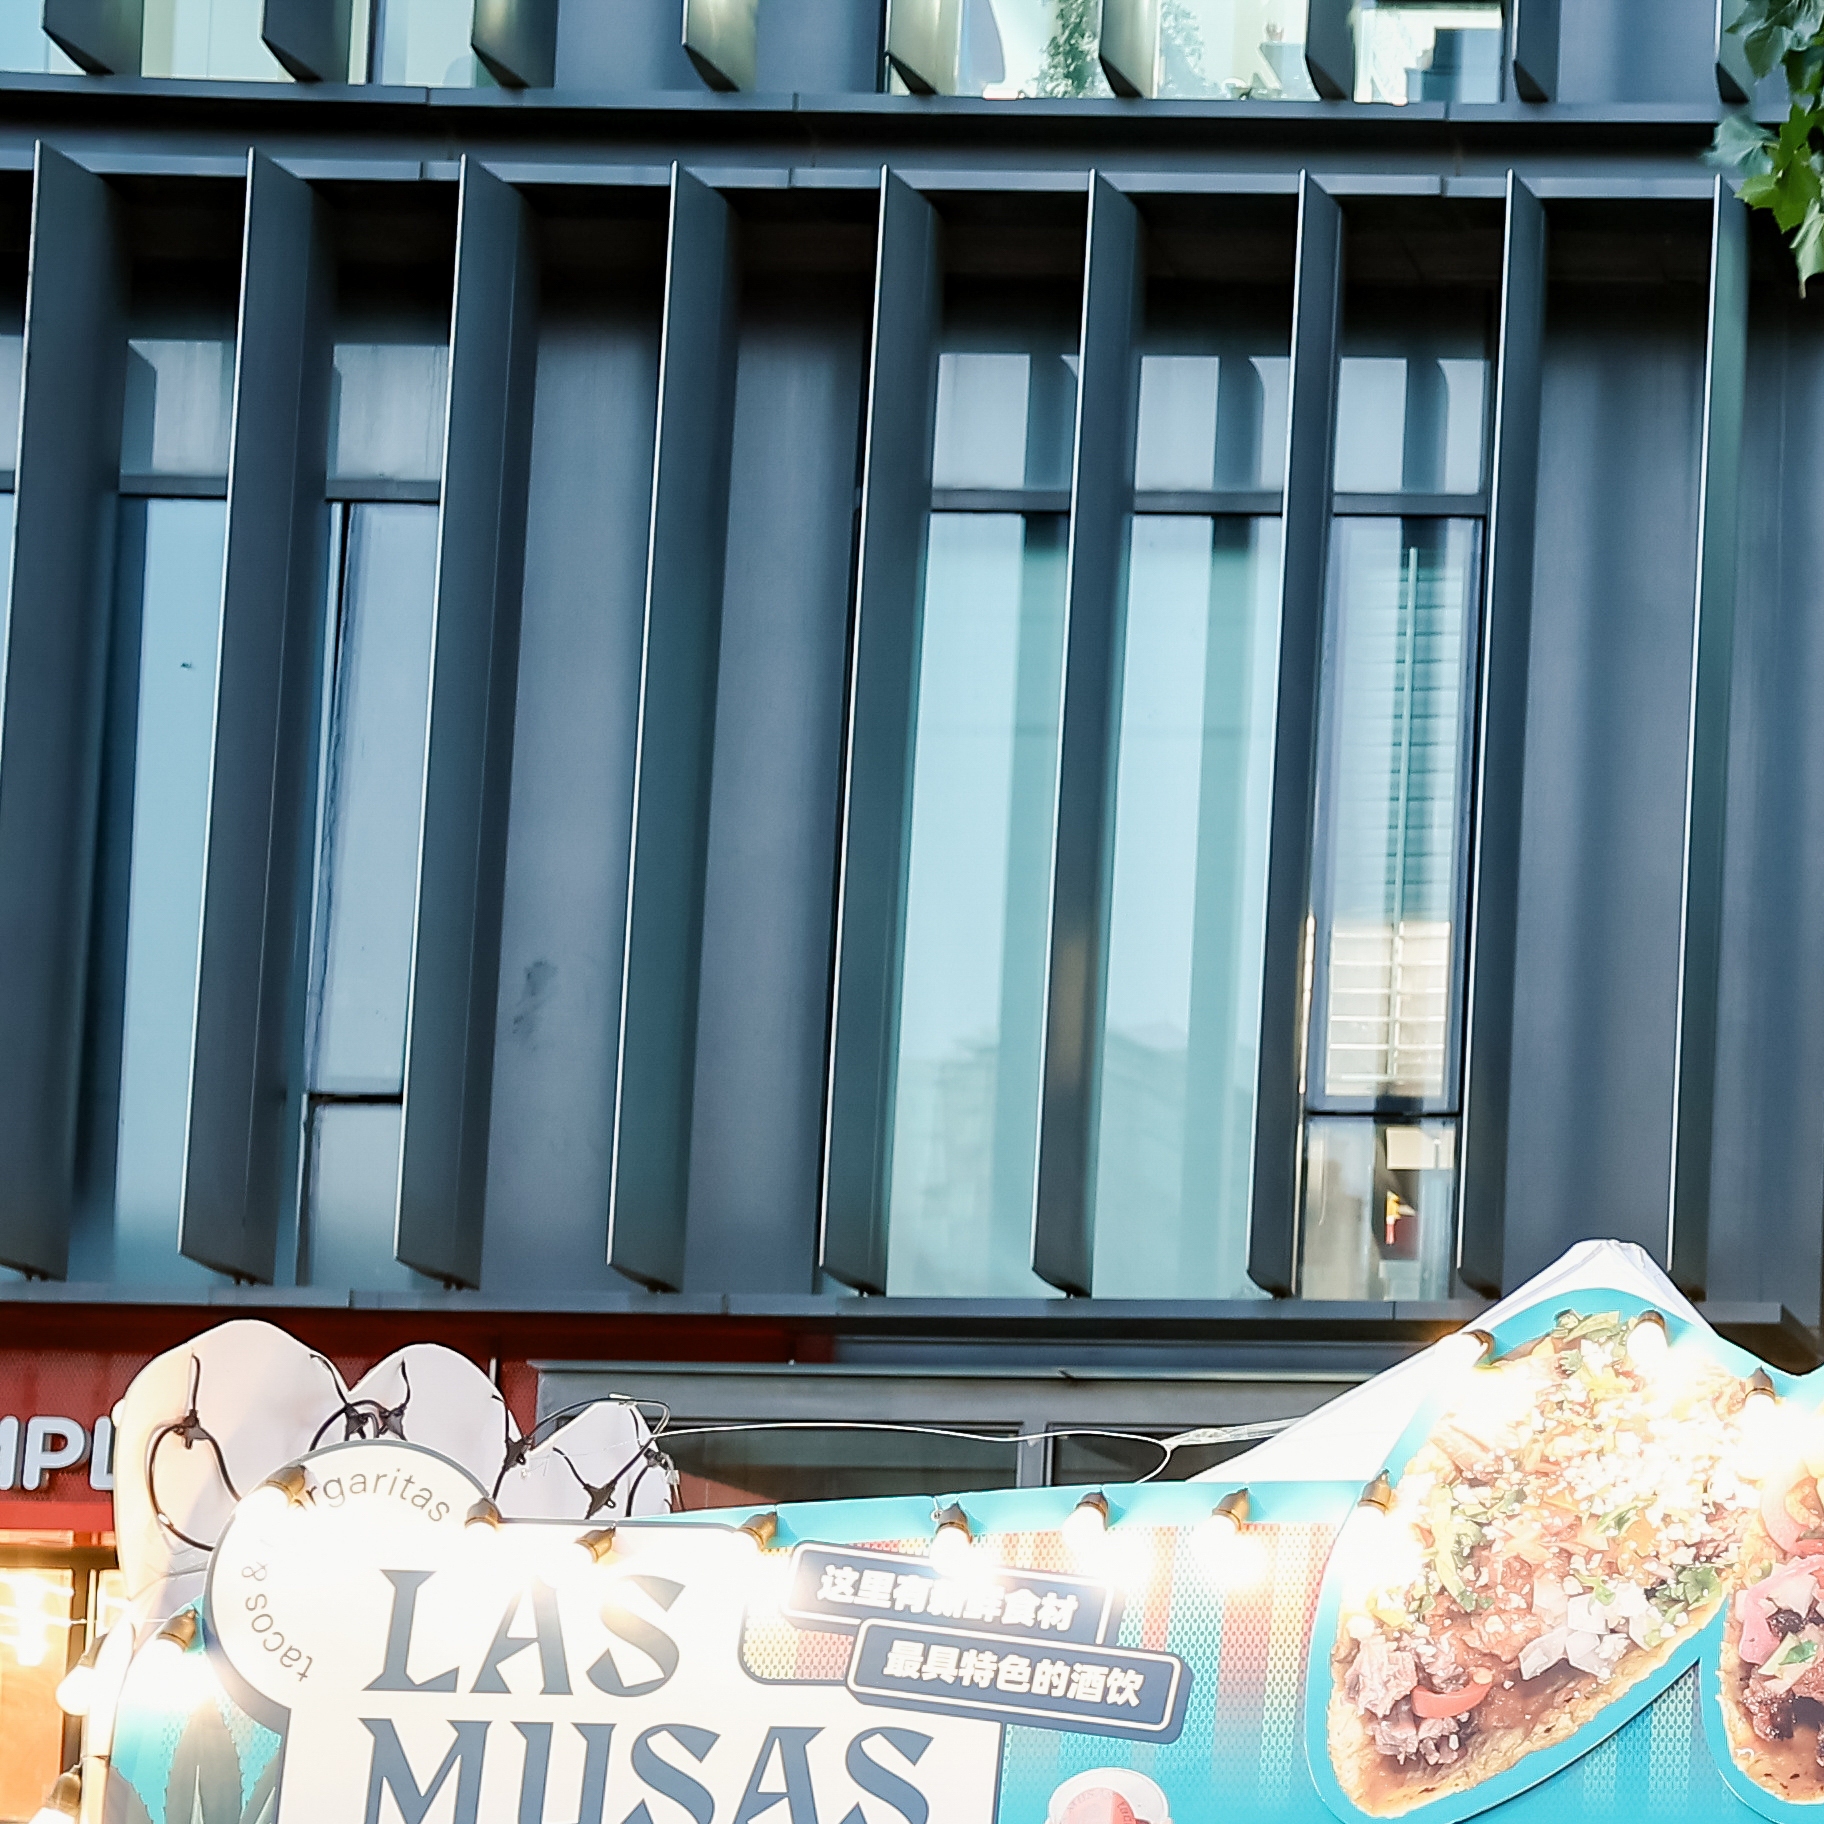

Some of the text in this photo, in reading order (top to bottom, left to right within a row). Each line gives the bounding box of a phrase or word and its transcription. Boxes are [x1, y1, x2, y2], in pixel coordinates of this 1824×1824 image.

[290, 1468, 450, 1522] rgaritas
[361, 1567, 687, 1698] LAS
[882, 1639, 1145, 1708] 最具特色的酒饮
